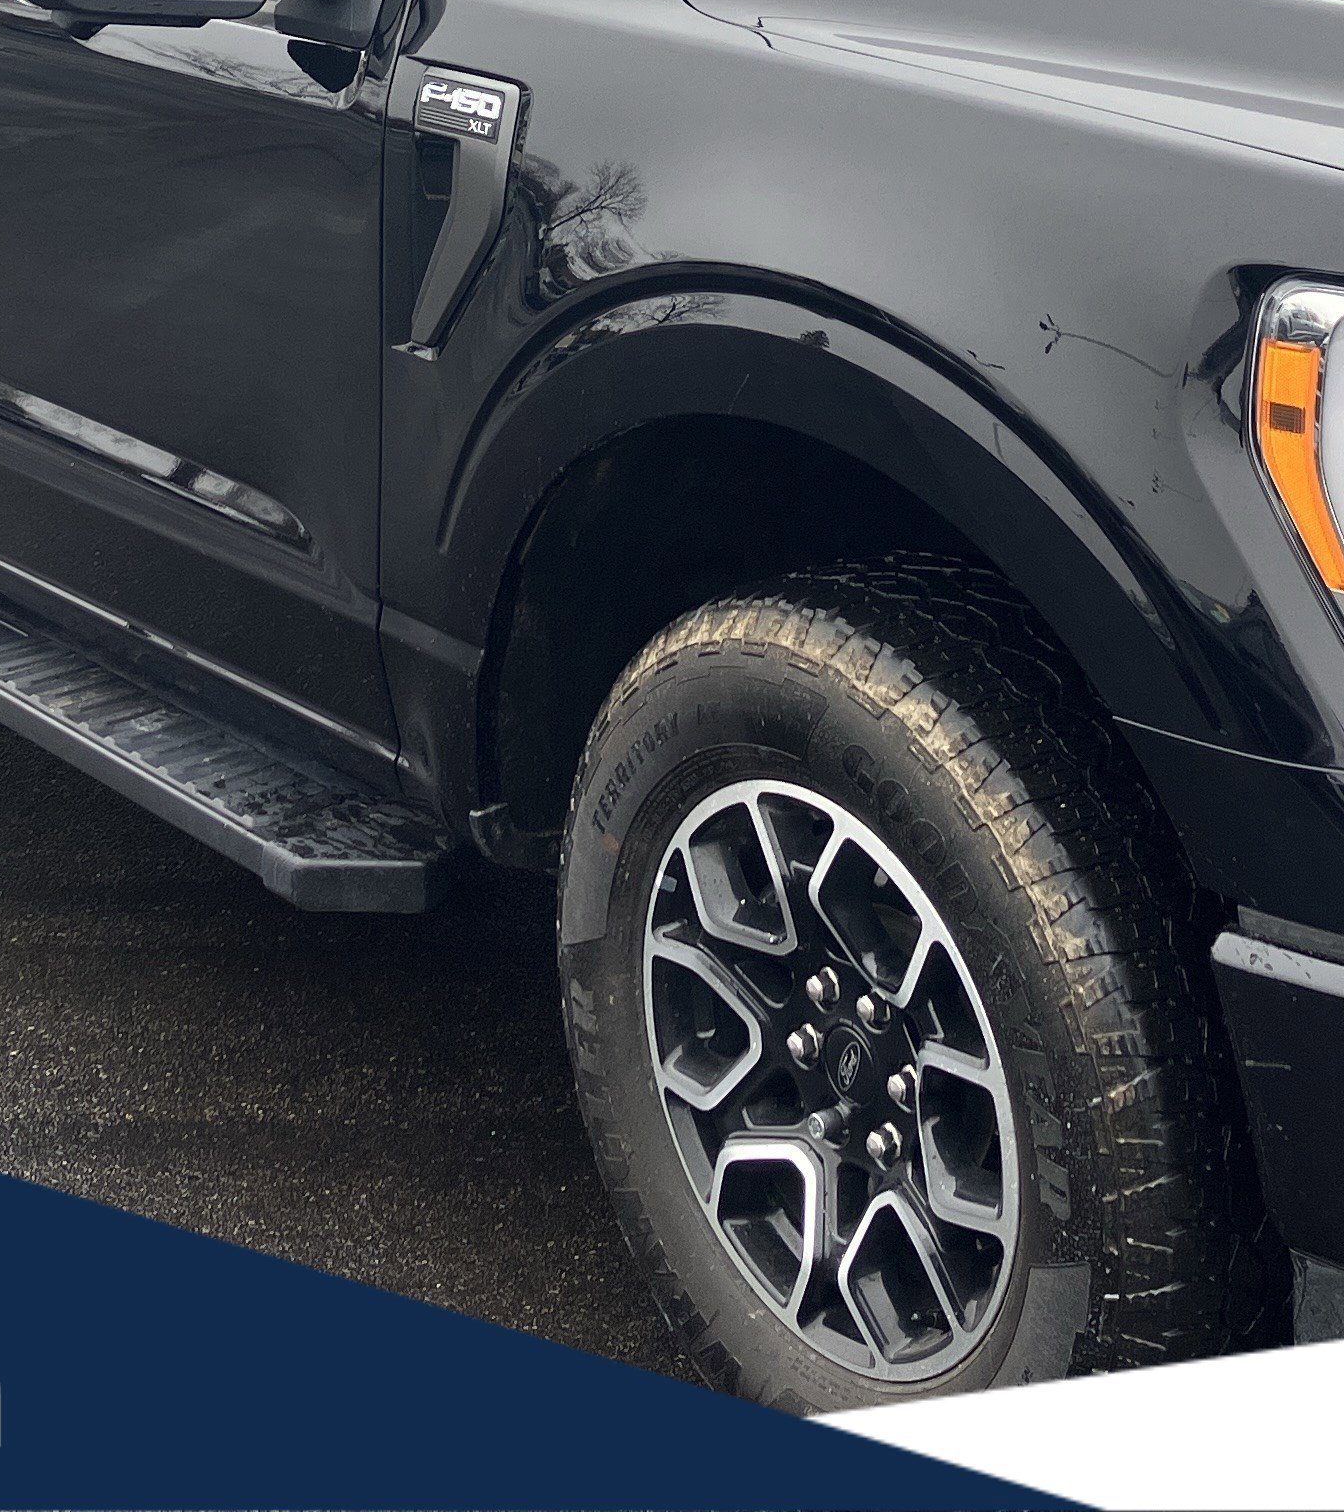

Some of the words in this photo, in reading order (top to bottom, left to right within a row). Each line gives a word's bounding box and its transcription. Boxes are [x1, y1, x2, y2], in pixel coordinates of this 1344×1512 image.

[419, 81, 502, 120] F-150
[467, 118, 493, 136] XLT
[591, 711, 679, 835] TERRITORY
